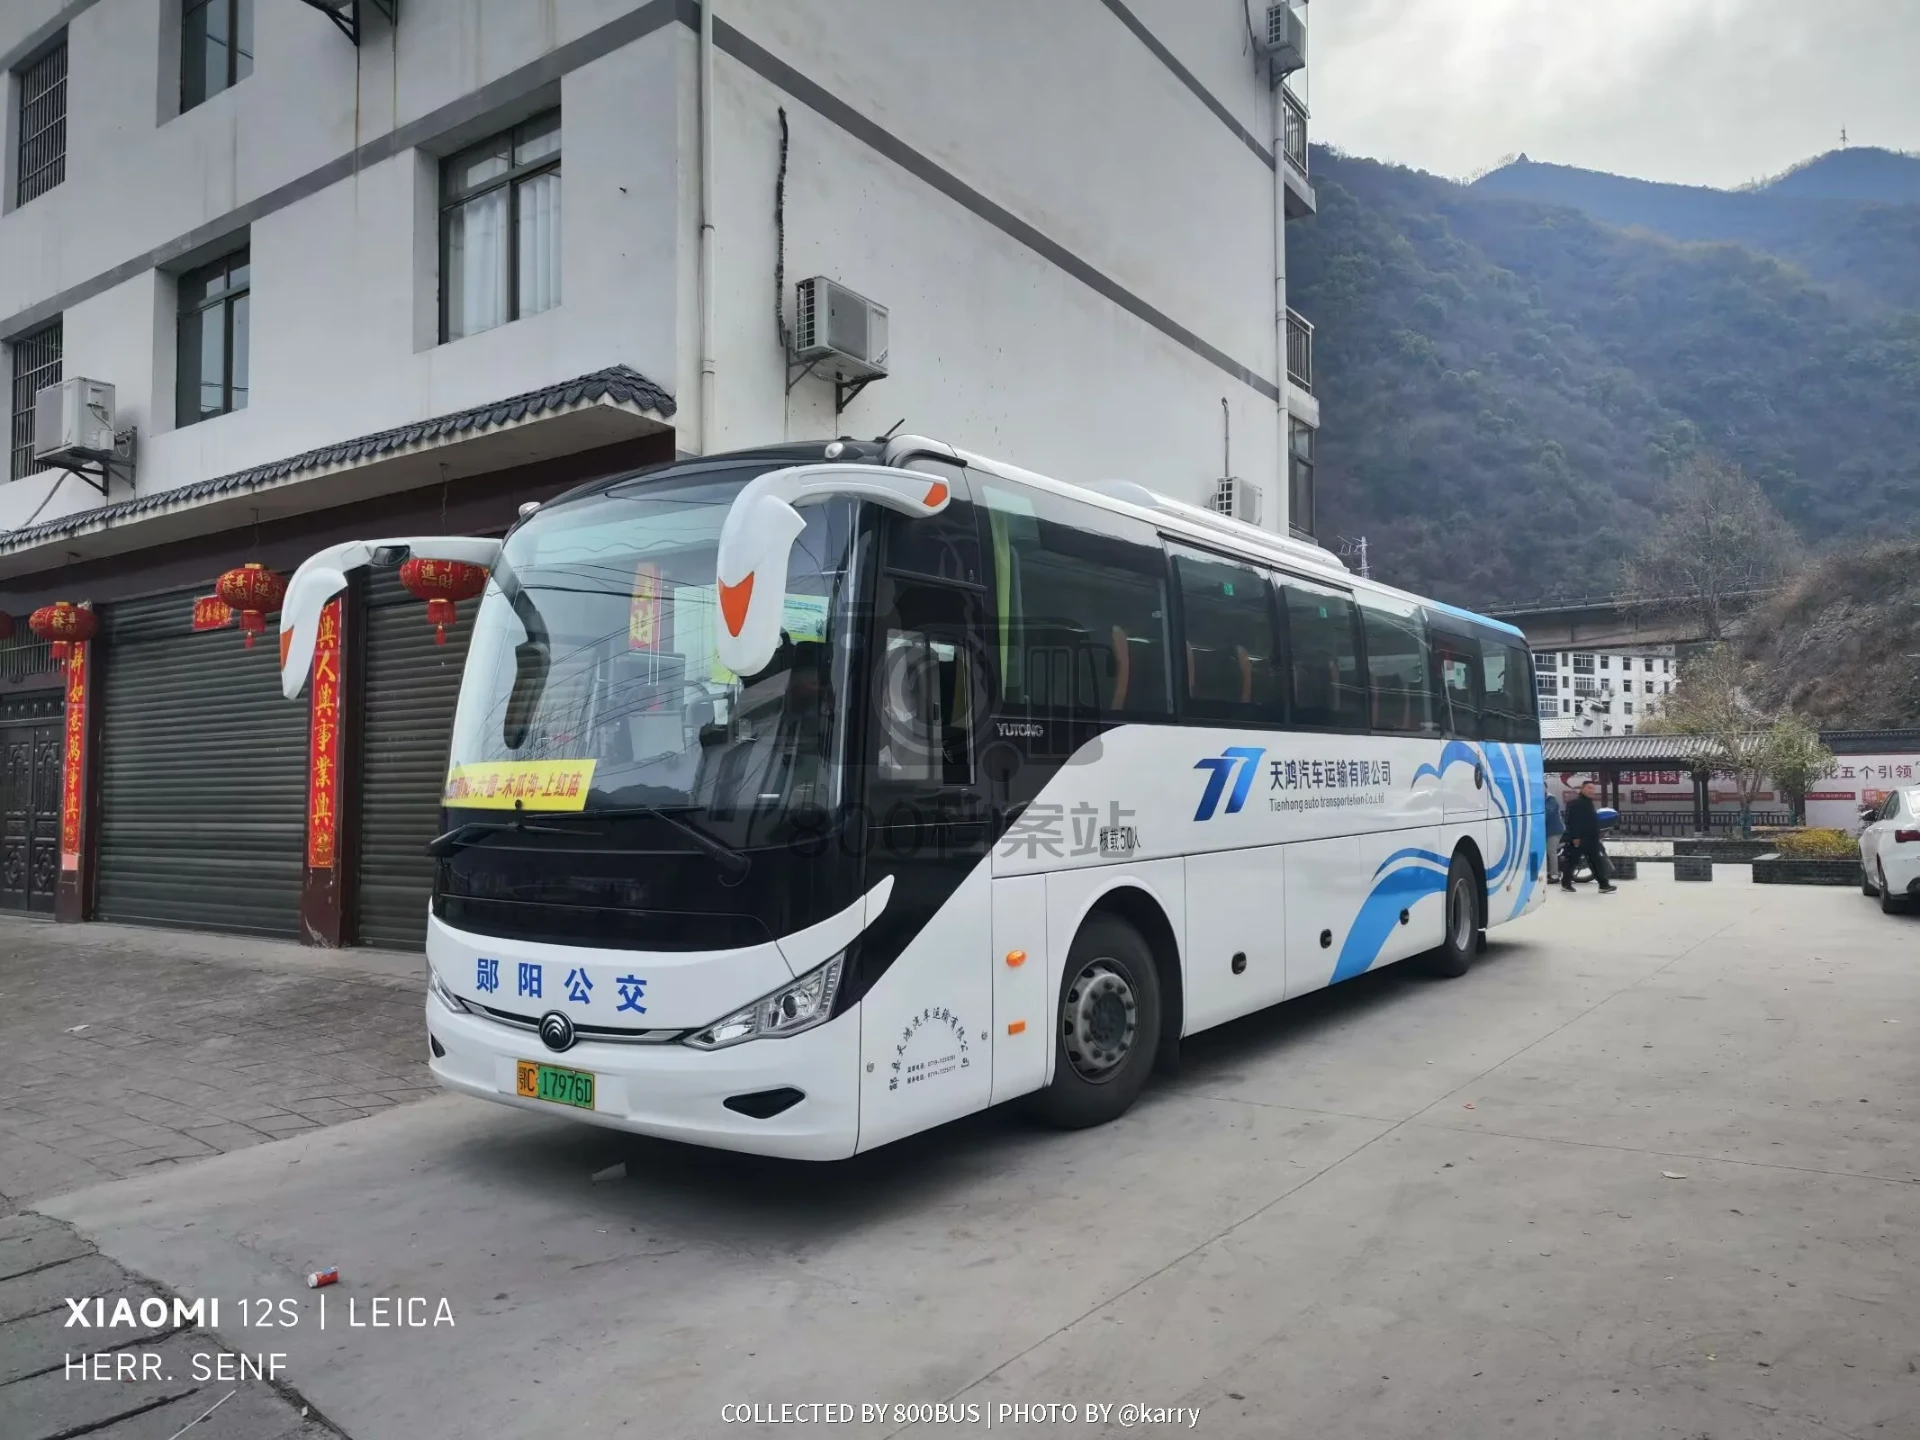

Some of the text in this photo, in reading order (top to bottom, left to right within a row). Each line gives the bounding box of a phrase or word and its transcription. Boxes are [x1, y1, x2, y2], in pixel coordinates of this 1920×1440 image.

[996, 722, 1044, 737] YUTONG
[1269, 759, 1391, 790] 天鸿汽车运输有限公司
[1269, 797, 1303, 812] Tianhong
[1304, 797, 1319, 809] auto
[476, 958, 648, 1015] 郧阳公交
